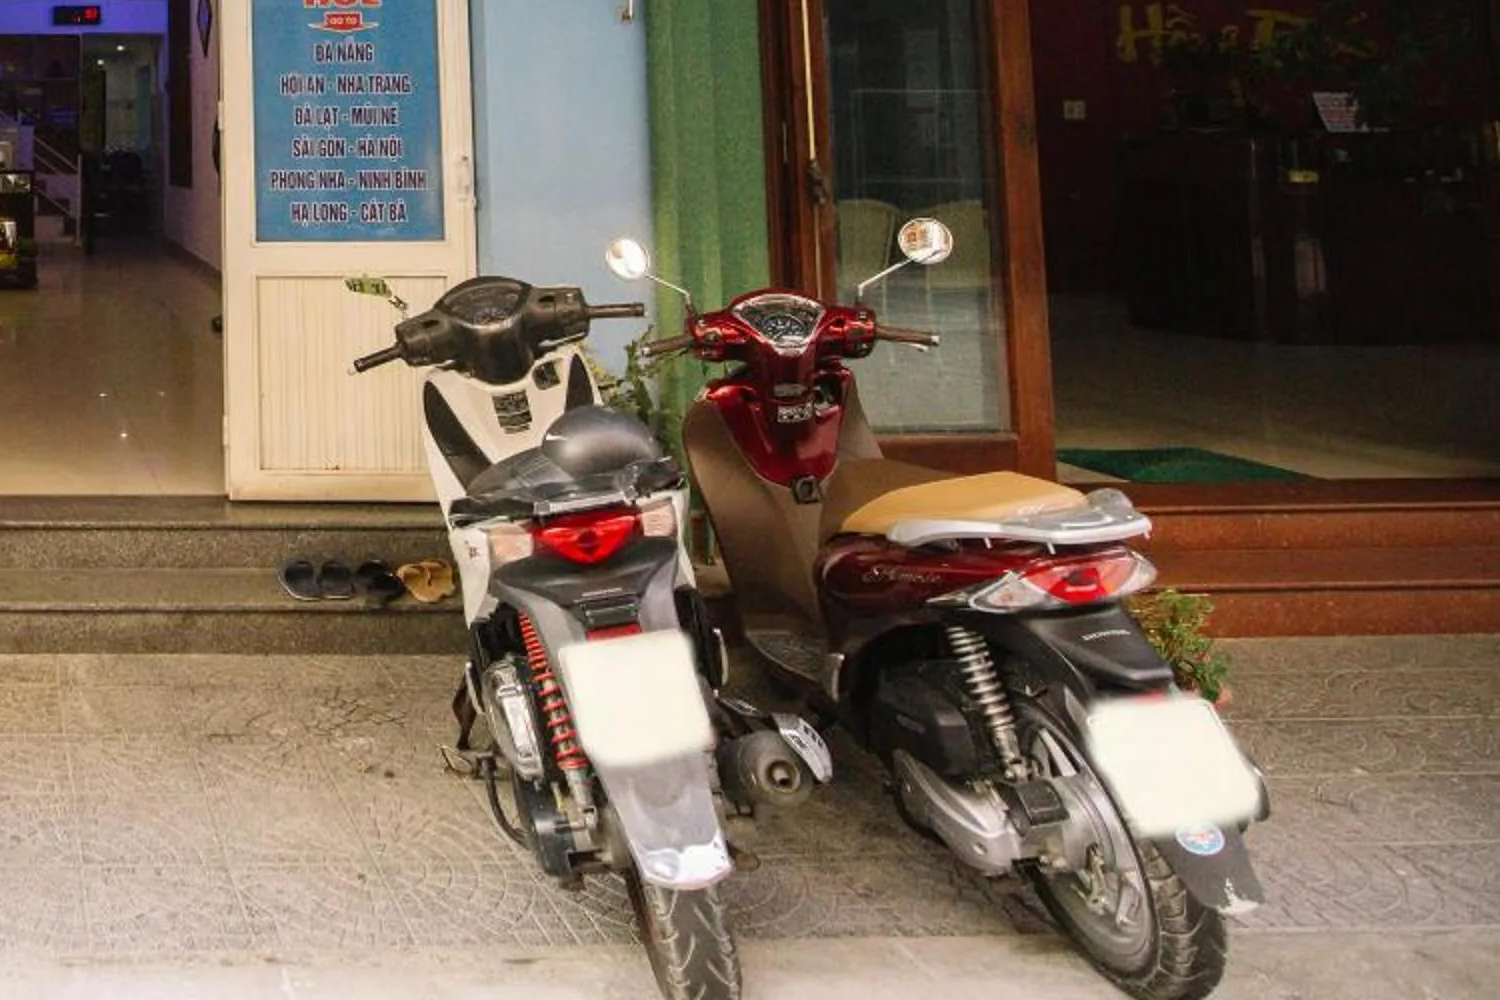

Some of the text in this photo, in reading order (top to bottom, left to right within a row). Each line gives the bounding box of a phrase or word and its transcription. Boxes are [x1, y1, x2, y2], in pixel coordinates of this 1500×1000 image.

[336, 74, 365, 95] NHA
[367, 74, 412, 95] TRANG
[271, 169, 315, 191] PHONG
[357, 169, 392, 190] NINH
[311, 201, 348, 223] LONG
